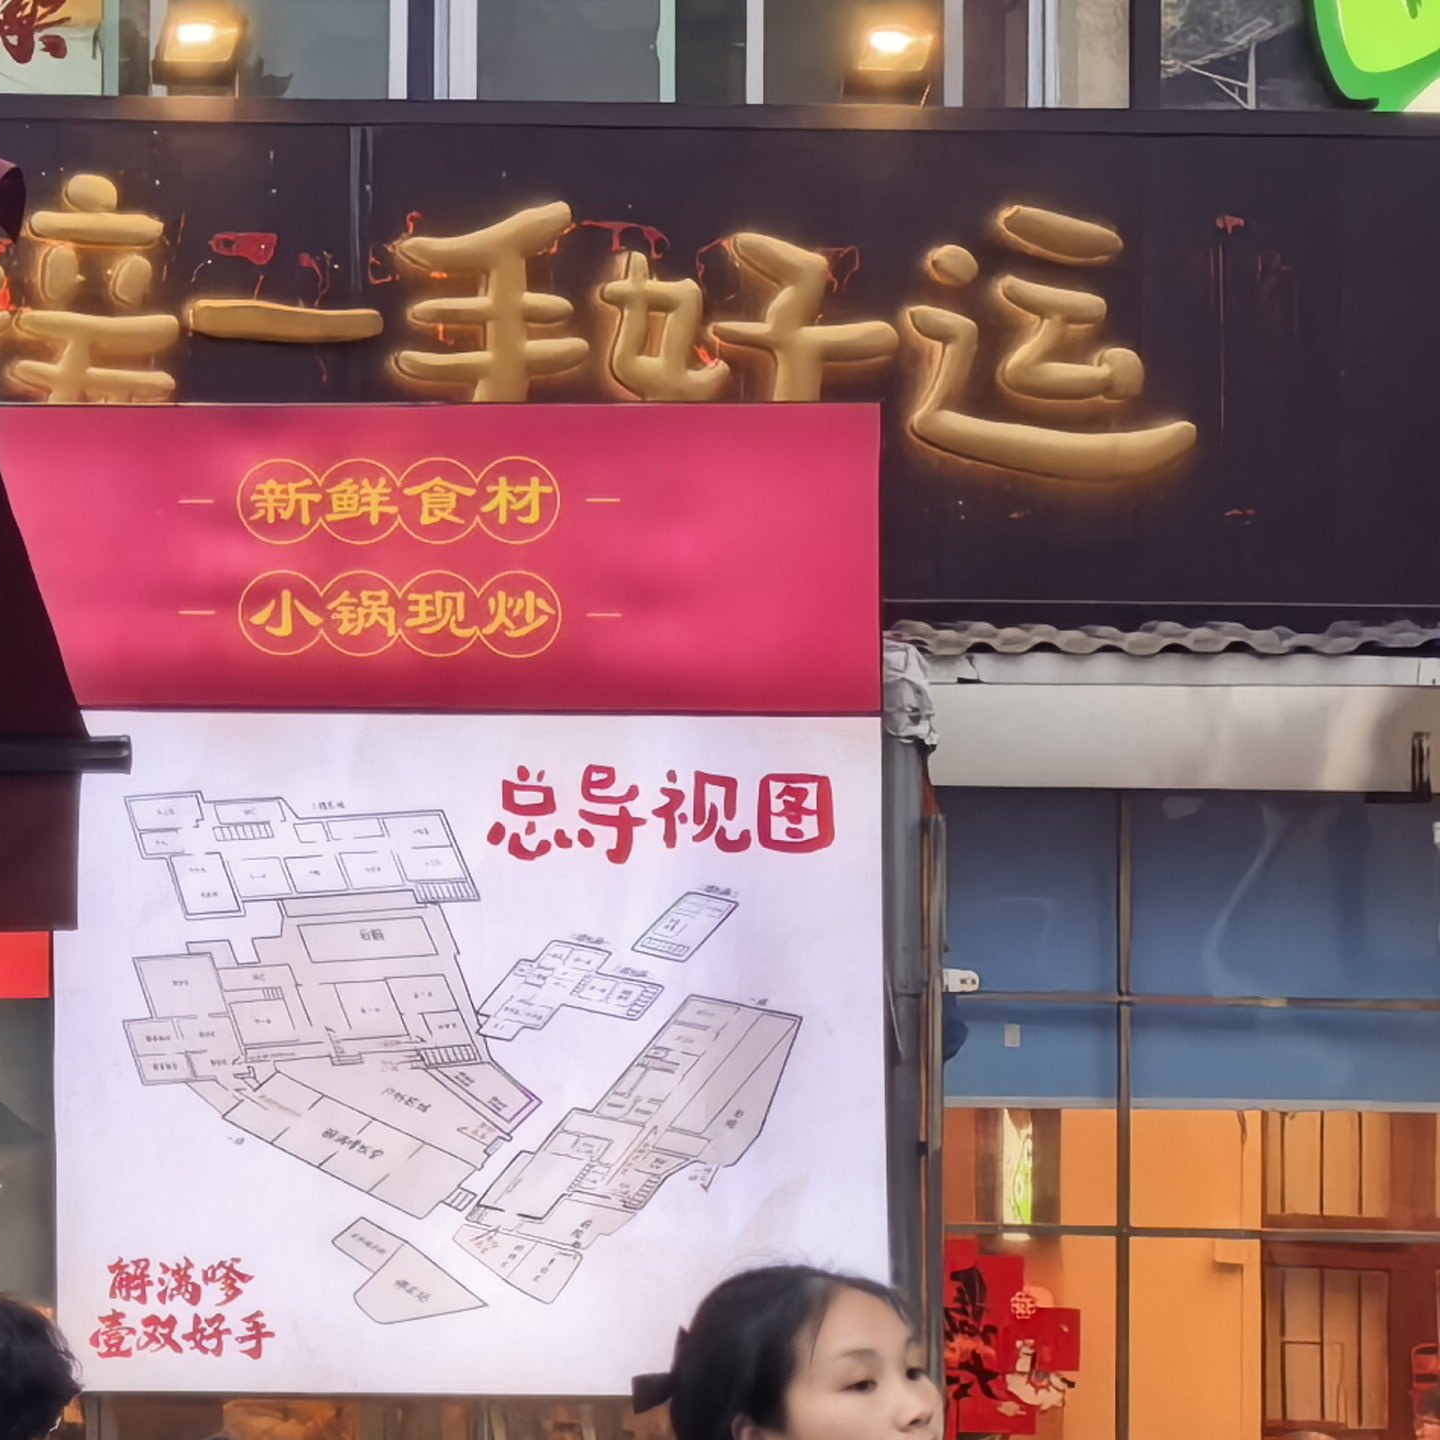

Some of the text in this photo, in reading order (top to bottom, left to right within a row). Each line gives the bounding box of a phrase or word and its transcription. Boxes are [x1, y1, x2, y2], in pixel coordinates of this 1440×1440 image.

[249, 475, 556, 528] 新鲜食材
[250, 584, 556, 640] 小锅现炒
[487, 765, 836, 863] 总导视图
[88, 1311, 277, 1363] 壹双好手
